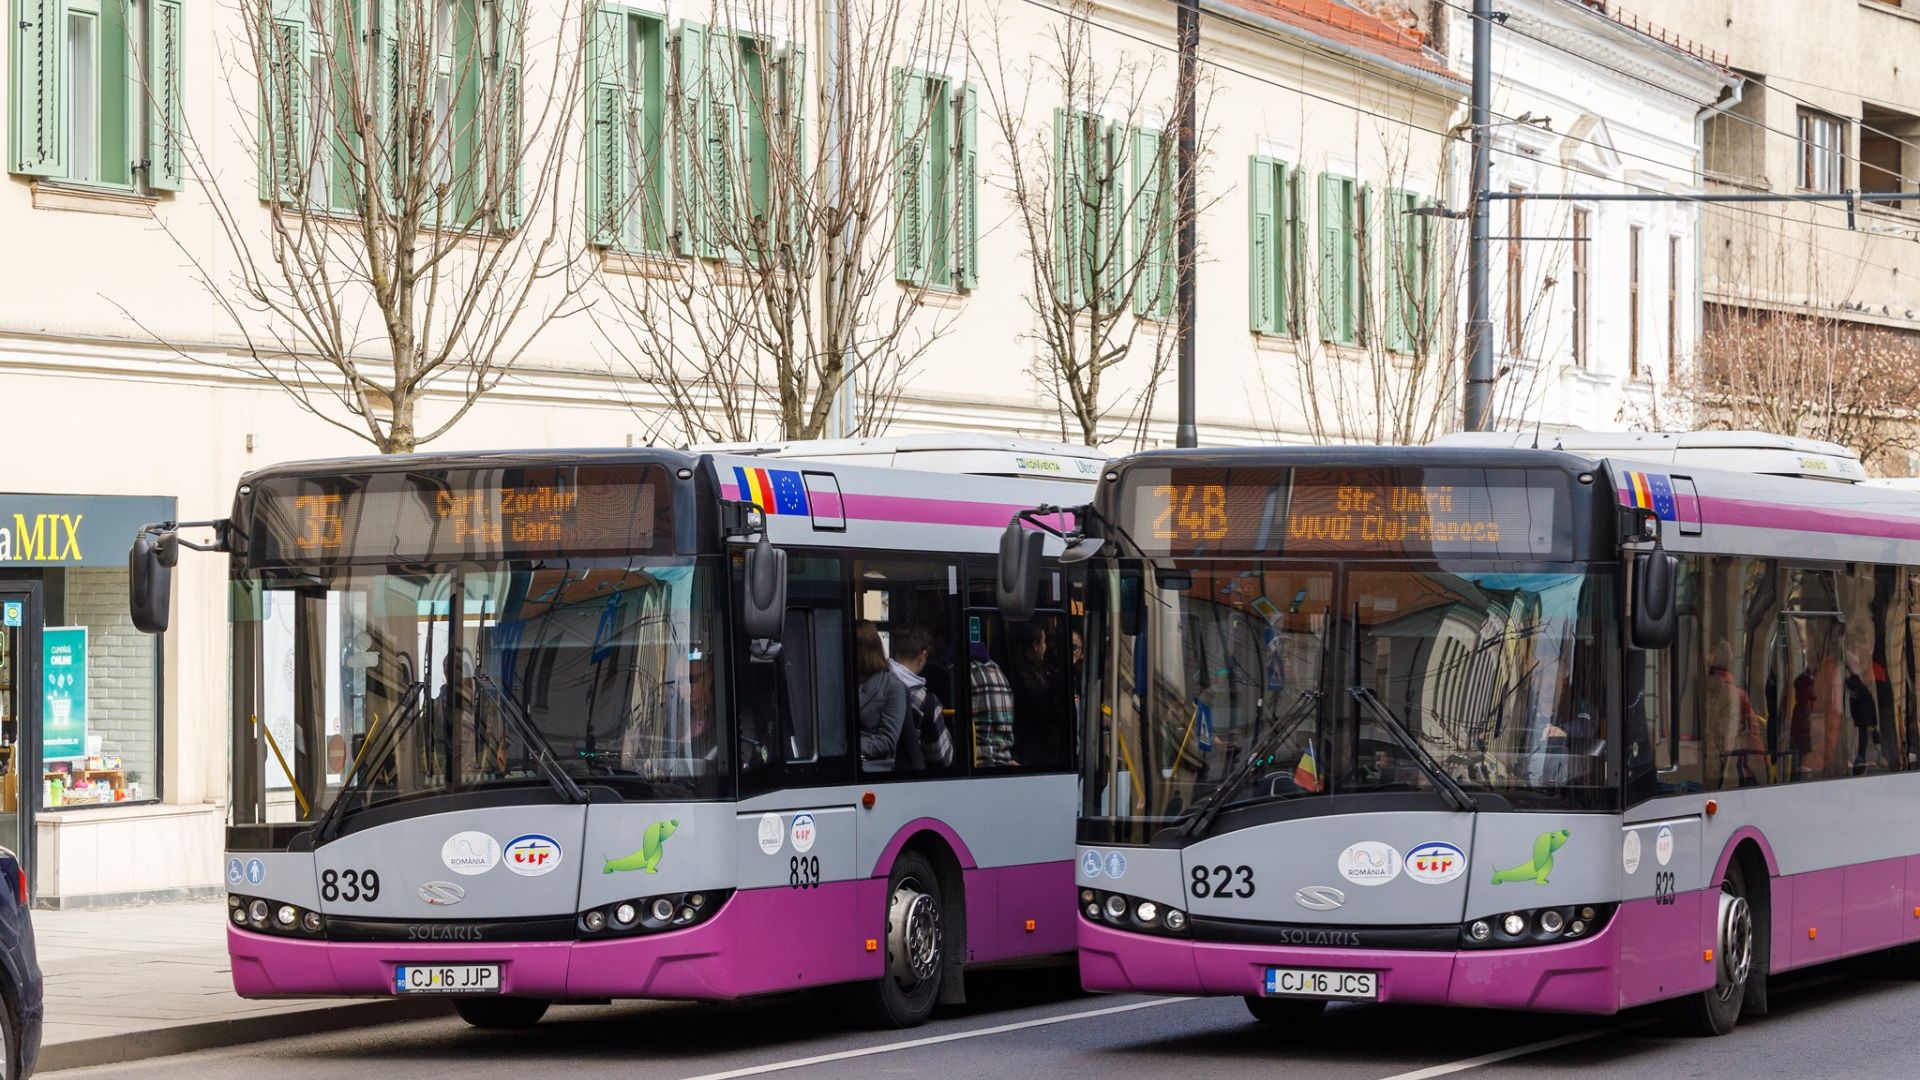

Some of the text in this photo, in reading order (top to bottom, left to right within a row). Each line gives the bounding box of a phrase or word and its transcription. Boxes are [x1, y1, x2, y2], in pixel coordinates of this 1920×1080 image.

[1153, 485, 1228, 539] 24B
[1335, 486, 1453, 512] Str. Unirii
[296, 495, 343, 549] 35
[1362, 514, 1500, 542] Cluj-Napoca
[50, 656, 72, 665] ONLINE
[321, 868, 380, 902] 839
[790, 855, 820, 890] 839
[1191, 865, 1256, 899] 823
[1655, 871, 1676, 905] 823
[408, 924, 483, 940] SOLARIS
[1280, 928, 1360, 946] SOLARIS
[411, 968, 433, 987] CJ
[439, 968, 455, 987] 16
[461, 967, 492, 987] JJP
[1281, 972, 1304, 991] CJ
[1311, 973, 1328, 992] 16
[1334, 974, 1371, 994] JCS
